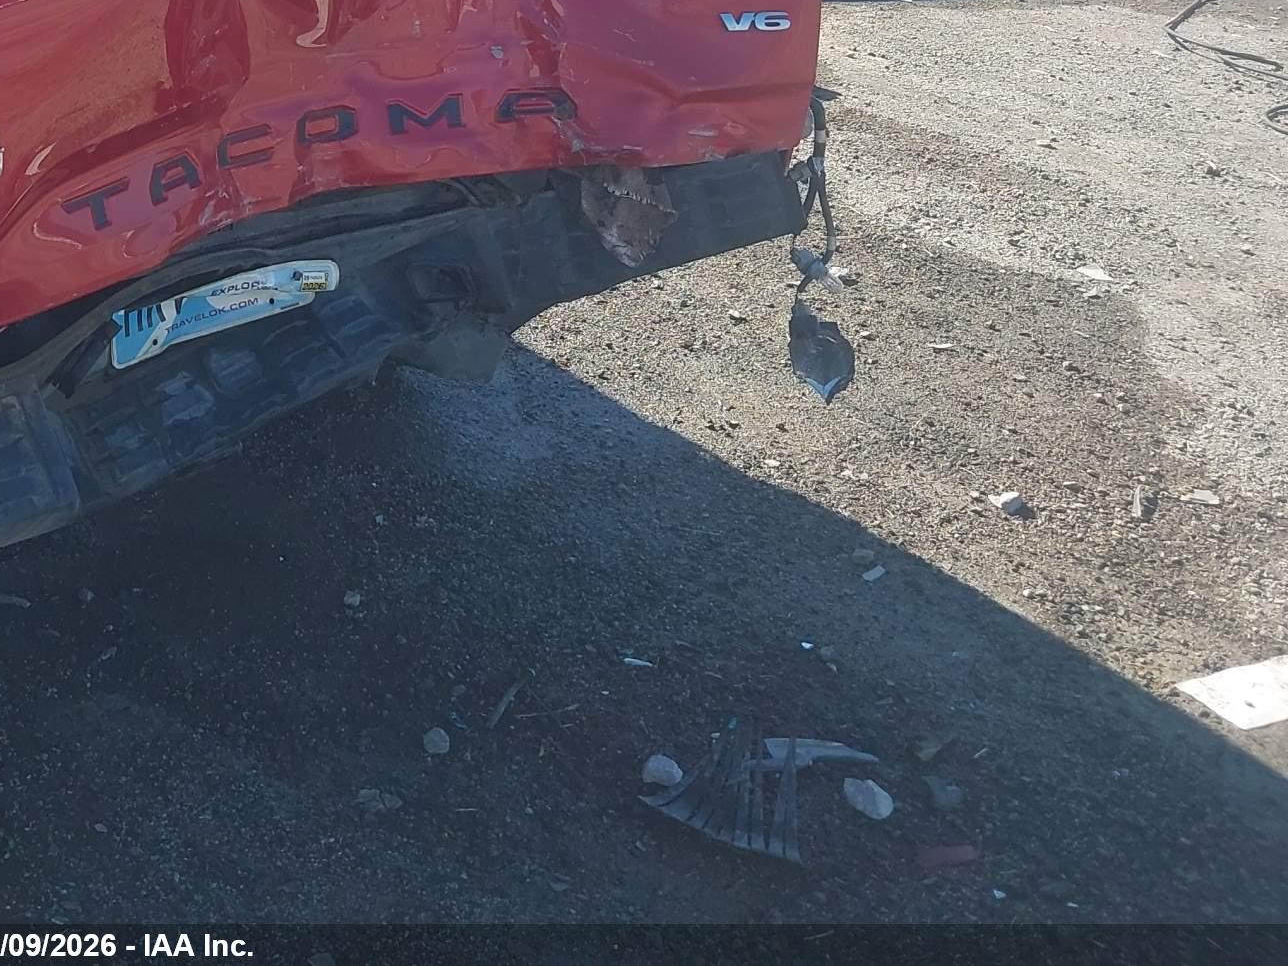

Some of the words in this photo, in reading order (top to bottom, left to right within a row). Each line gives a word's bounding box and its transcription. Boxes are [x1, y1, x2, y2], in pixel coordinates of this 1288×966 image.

[719, 11, 791, 32] V6
[63, 87, 579, 231] TACOMA
[166, 297, 259, 333] TRAVELOK.COM
